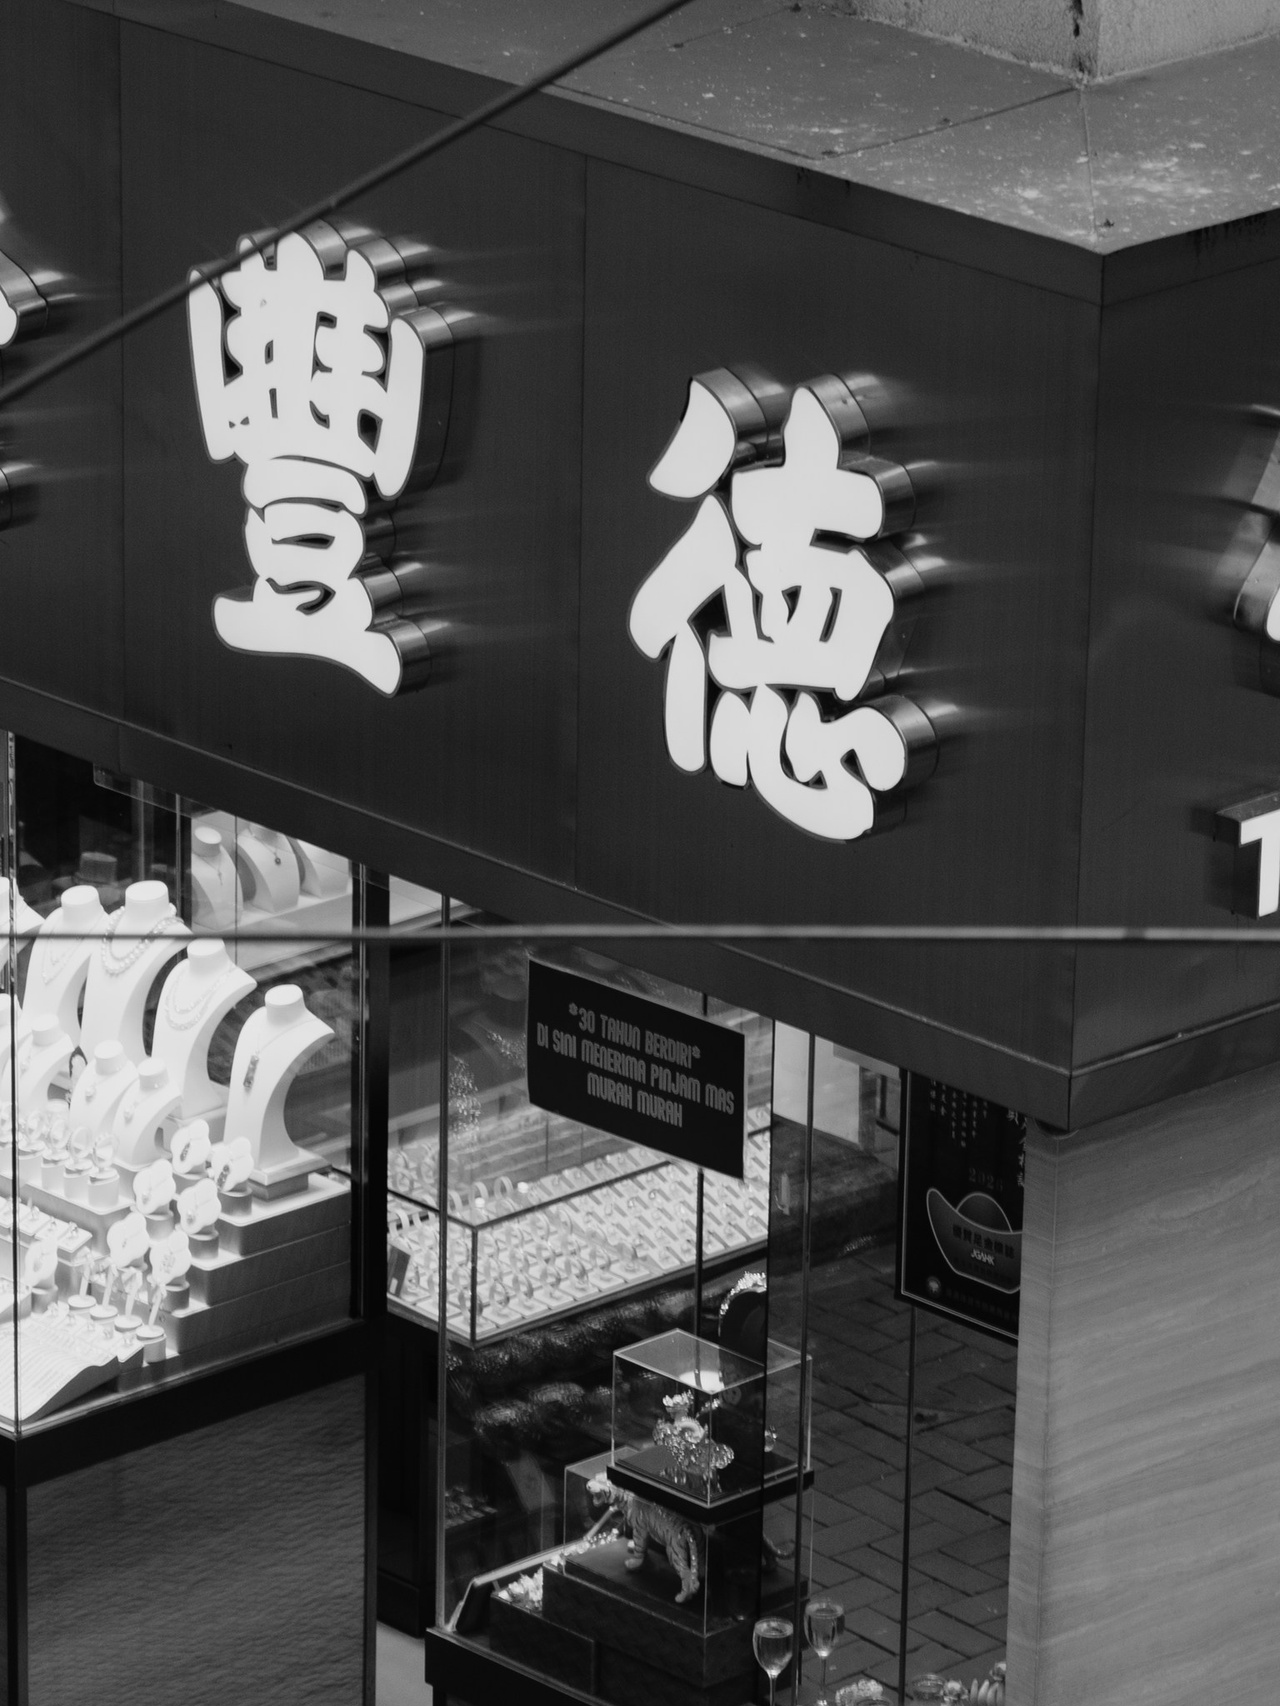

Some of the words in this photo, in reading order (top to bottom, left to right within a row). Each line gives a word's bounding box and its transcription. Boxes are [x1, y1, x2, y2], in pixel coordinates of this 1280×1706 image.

[600, 1014, 640, 1051] TAHUN
[537, 1022, 549, 1049] DI
[552, 1029, 577, 1059] SINI
[582, 1039, 646, 1085] MENERIMA
[651, 1063, 700, 1104] PINJAM
[705, 1082, 735, 1116] MAS
[587, 1072, 633, 1110] MURAH
[637, 1090, 683, 1128] MURAH
